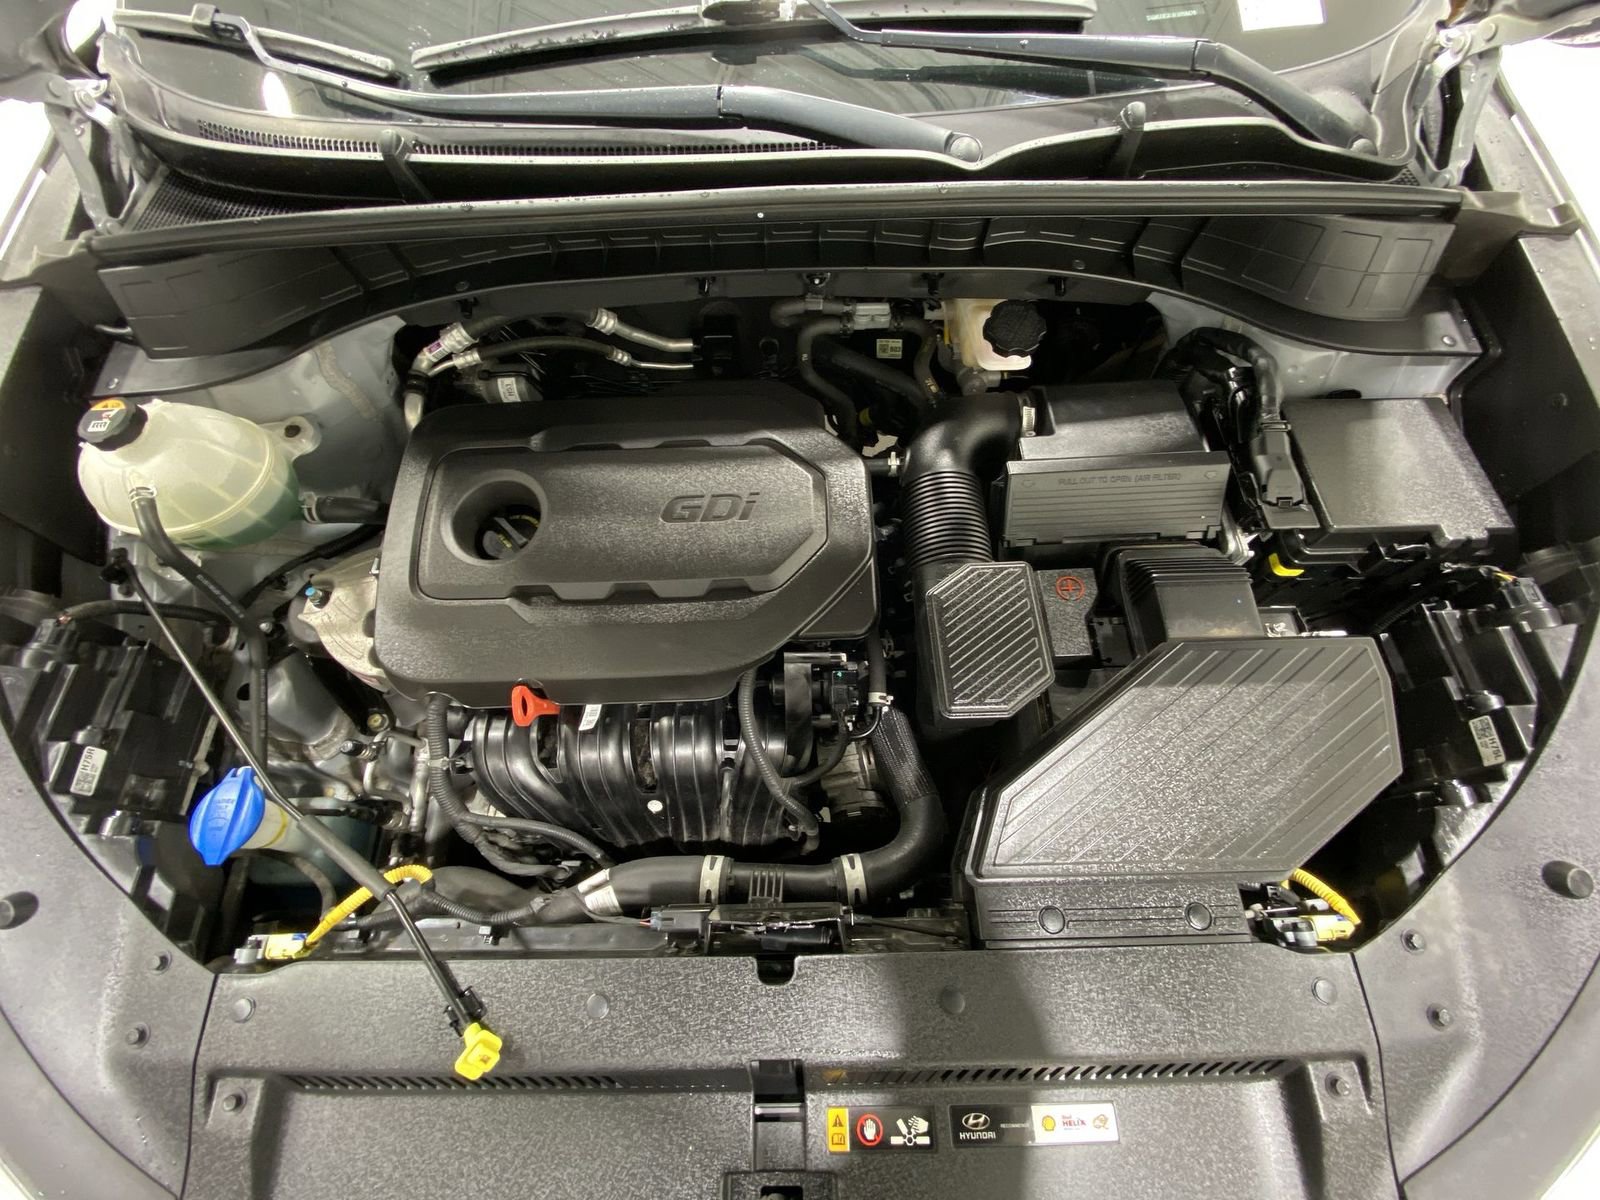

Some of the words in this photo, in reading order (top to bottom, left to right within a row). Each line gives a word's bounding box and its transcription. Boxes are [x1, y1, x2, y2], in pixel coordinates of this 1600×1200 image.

[1058, 477, 1078, 486] PULL
[1079, 476, 1097, 485] OUT
[1097, 475, 1108, 484] TO
[1110, 474, 1132, 483] OPEN
[660, 492, 760, 523] GDi
[1062, 1119, 1087, 1127] HELIX
[959, 1131, 997, 1140] HYUNDAI
